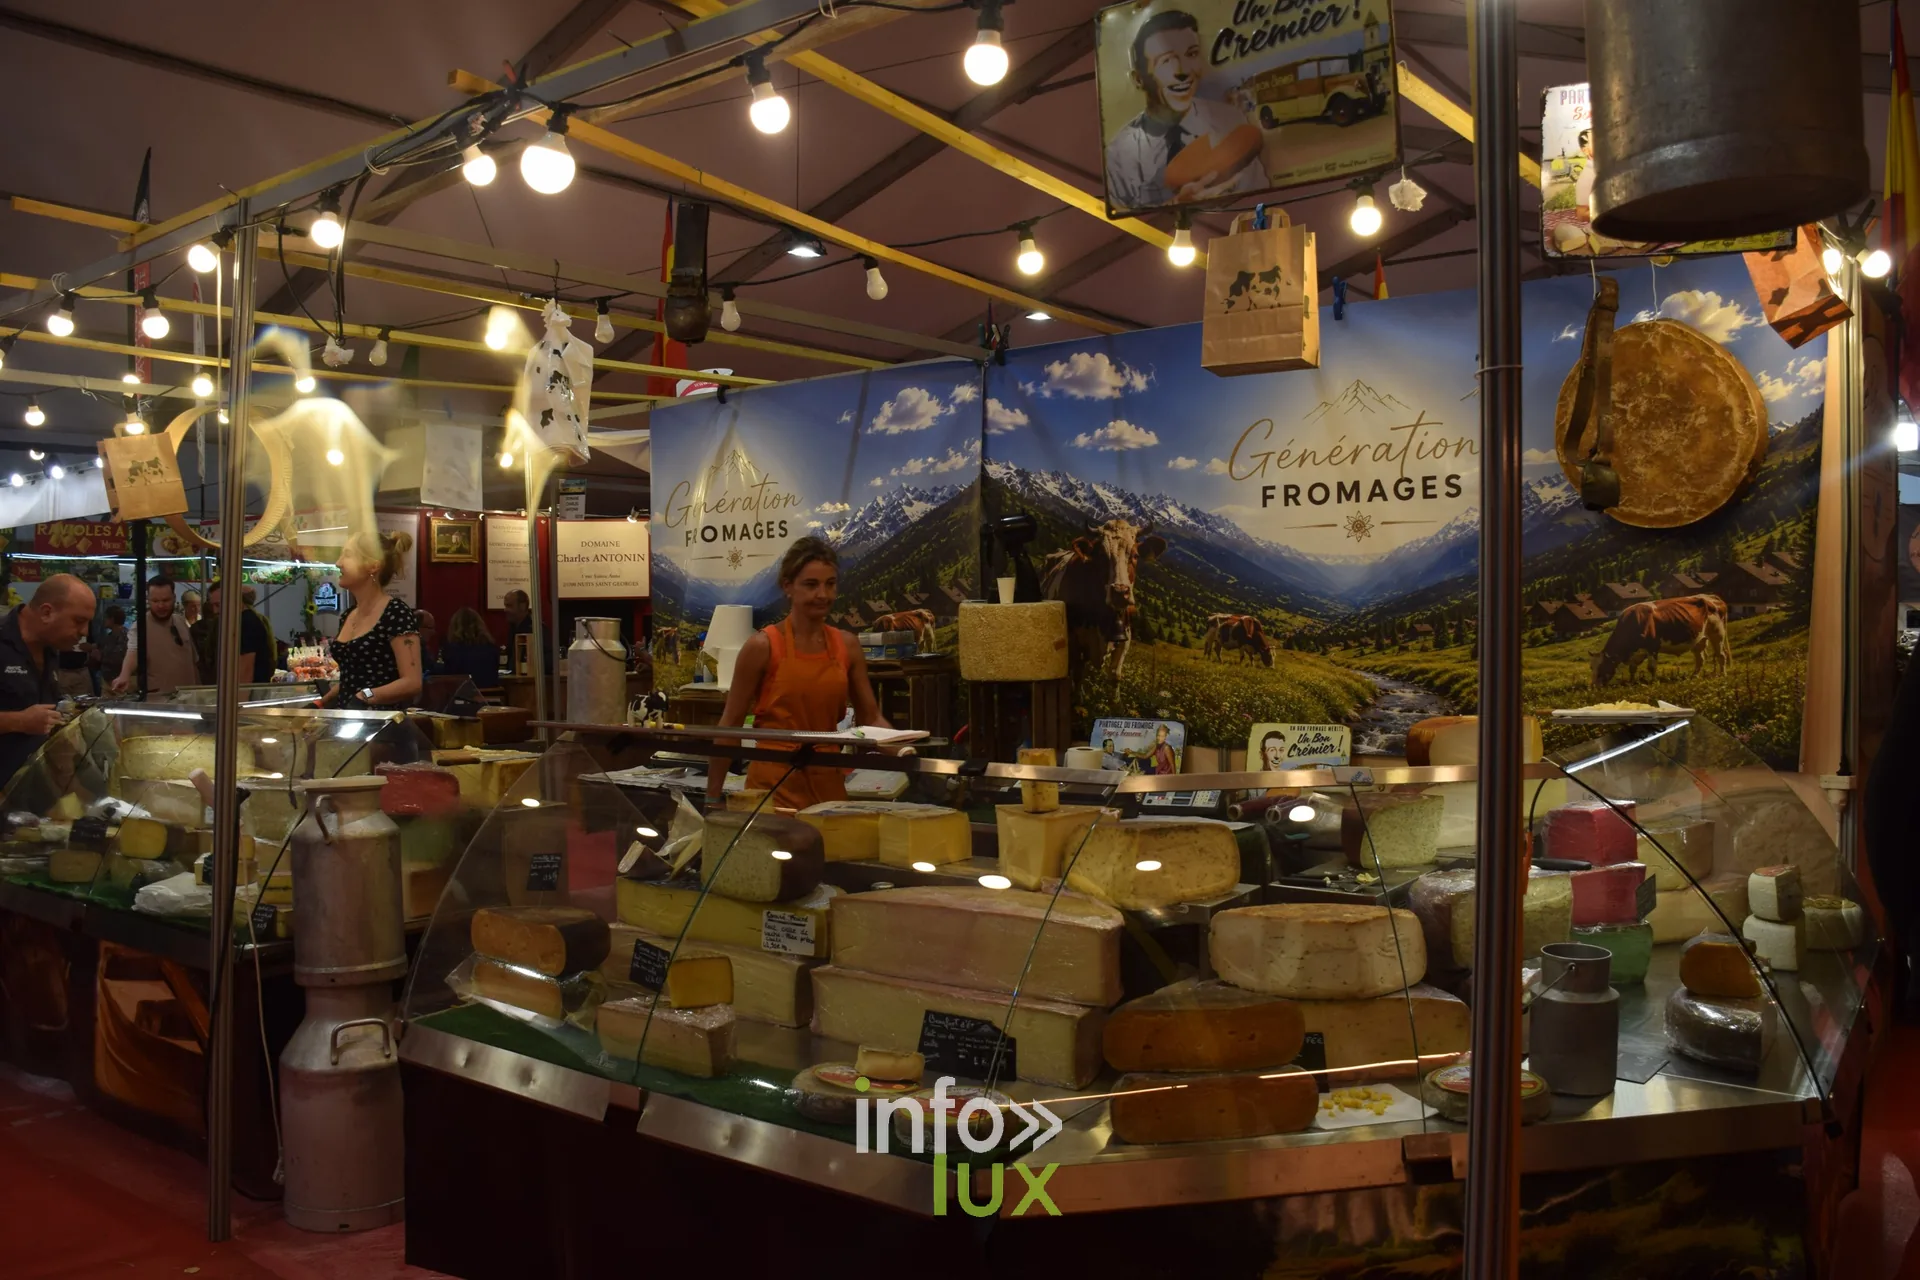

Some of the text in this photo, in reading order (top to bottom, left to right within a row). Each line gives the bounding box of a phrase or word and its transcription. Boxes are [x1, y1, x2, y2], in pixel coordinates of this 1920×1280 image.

[1229, 410, 1479, 481] Génération
[664, 473, 803, 528] Gnération
[1262, 474, 1462, 508] FROMAGES
[37, 523, 112, 537] RAVIOLES
[685, 520, 788, 547] FROMAGES
[556, 553, 646, 563] Charles ANTONIN
[1297, 732, 1332, 744] Un Bon
